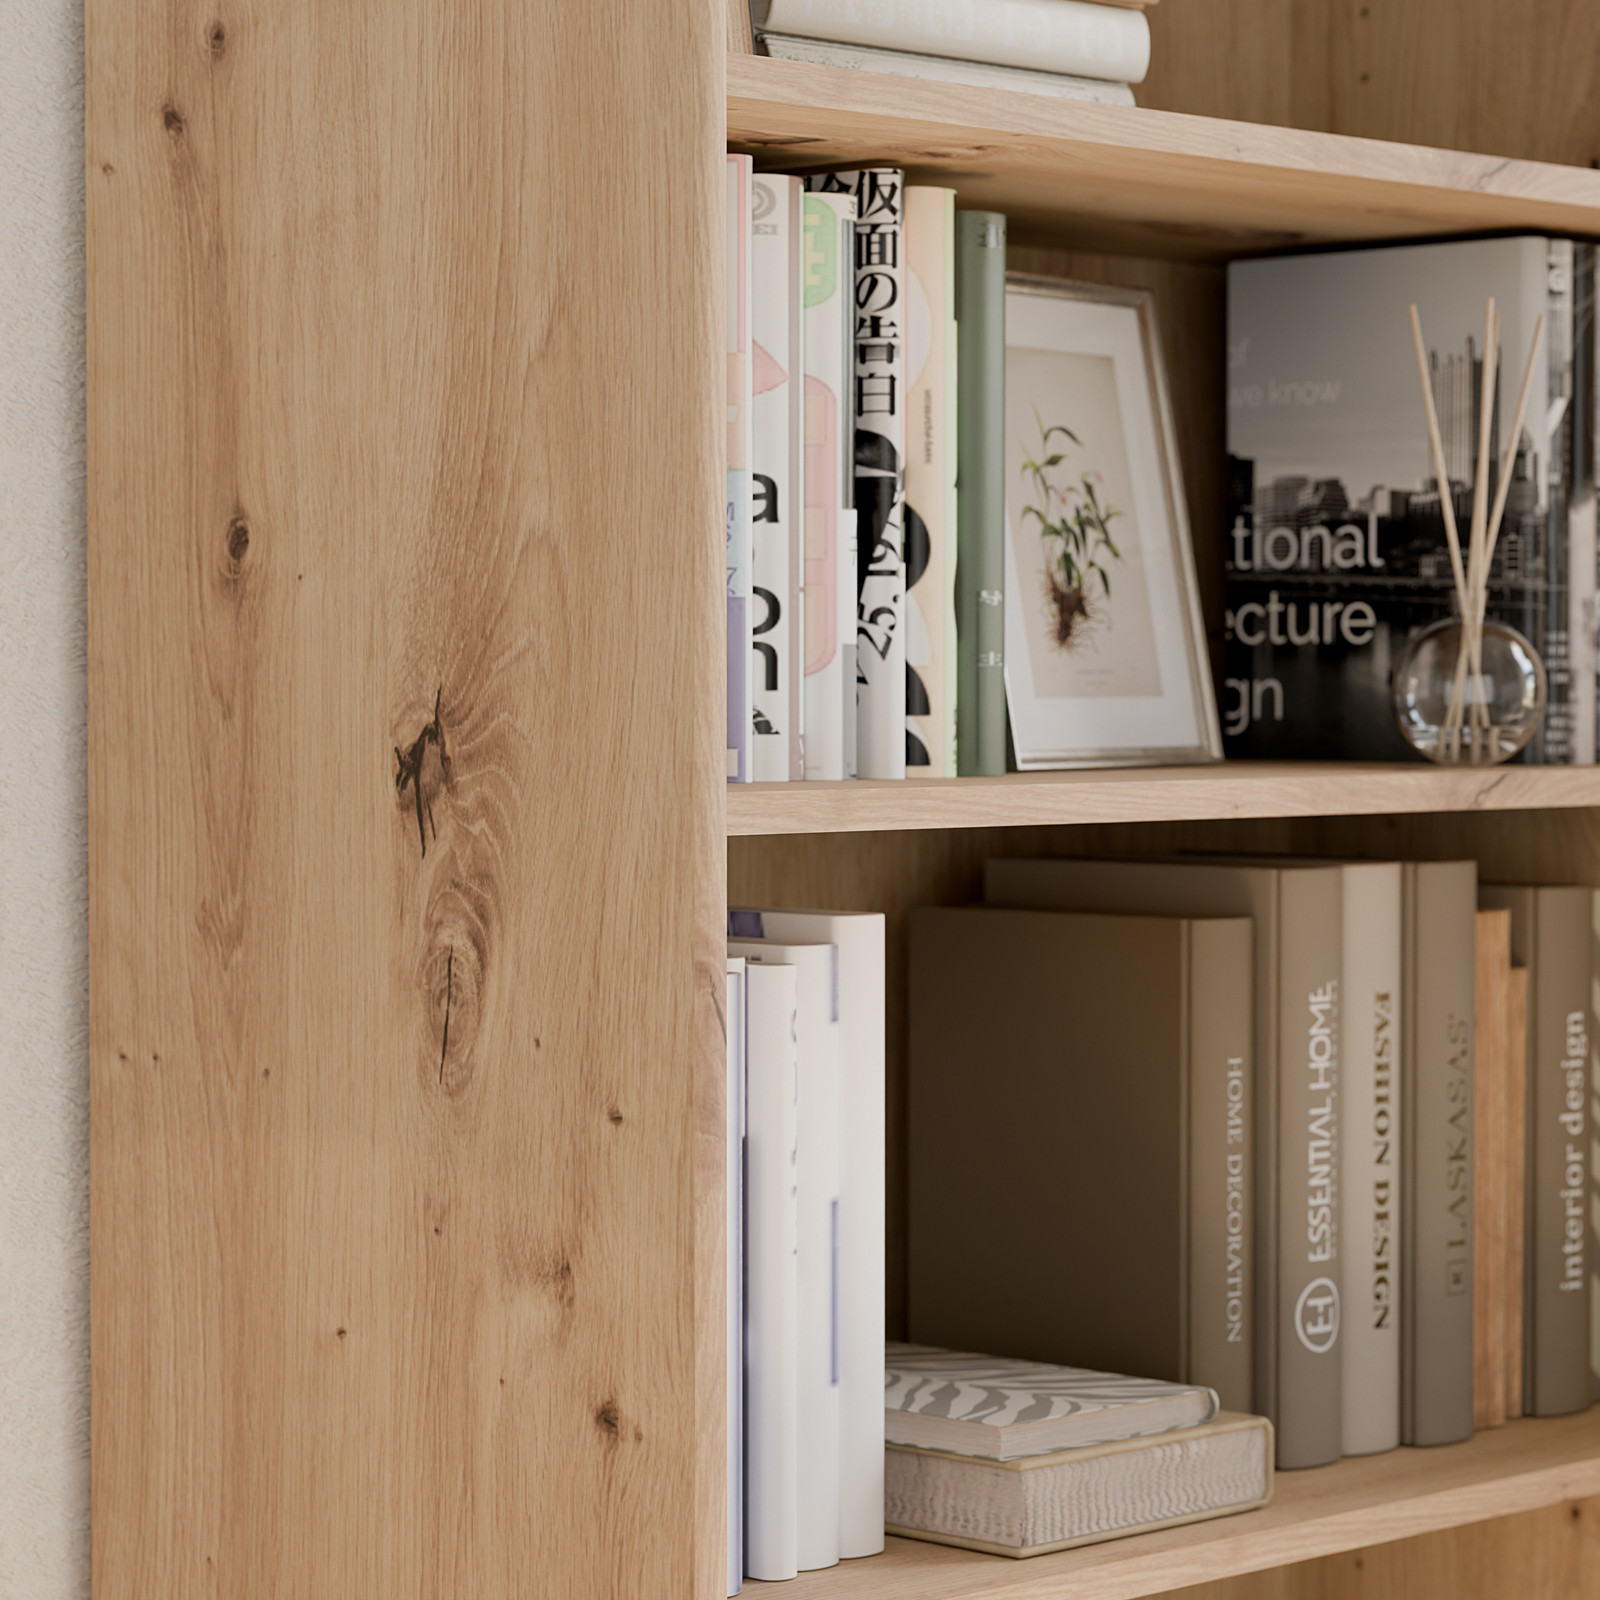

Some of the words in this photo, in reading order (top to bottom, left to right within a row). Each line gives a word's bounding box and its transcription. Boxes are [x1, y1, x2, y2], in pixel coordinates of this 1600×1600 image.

[855, 169, 898, 417] 仮面の告白
[1267, 376, 1342, 405] know
[1226, 512, 1386, 571] tional
[1226, 1056, 1244, 1145] HOME
[1308, 981, 1335, 1092] HOME
[1373, 991, 1392, 1166] FASHION
[1558, 1010, 1589, 1137] design
[1226, 1154, 1244, 1343] DECORATION
[1308, 1096, 1333, 1264] ESSENTIAL
[1559, 1143, 1585, 1292] interior
[1373, 1179, 1392, 1331] DESIGN
